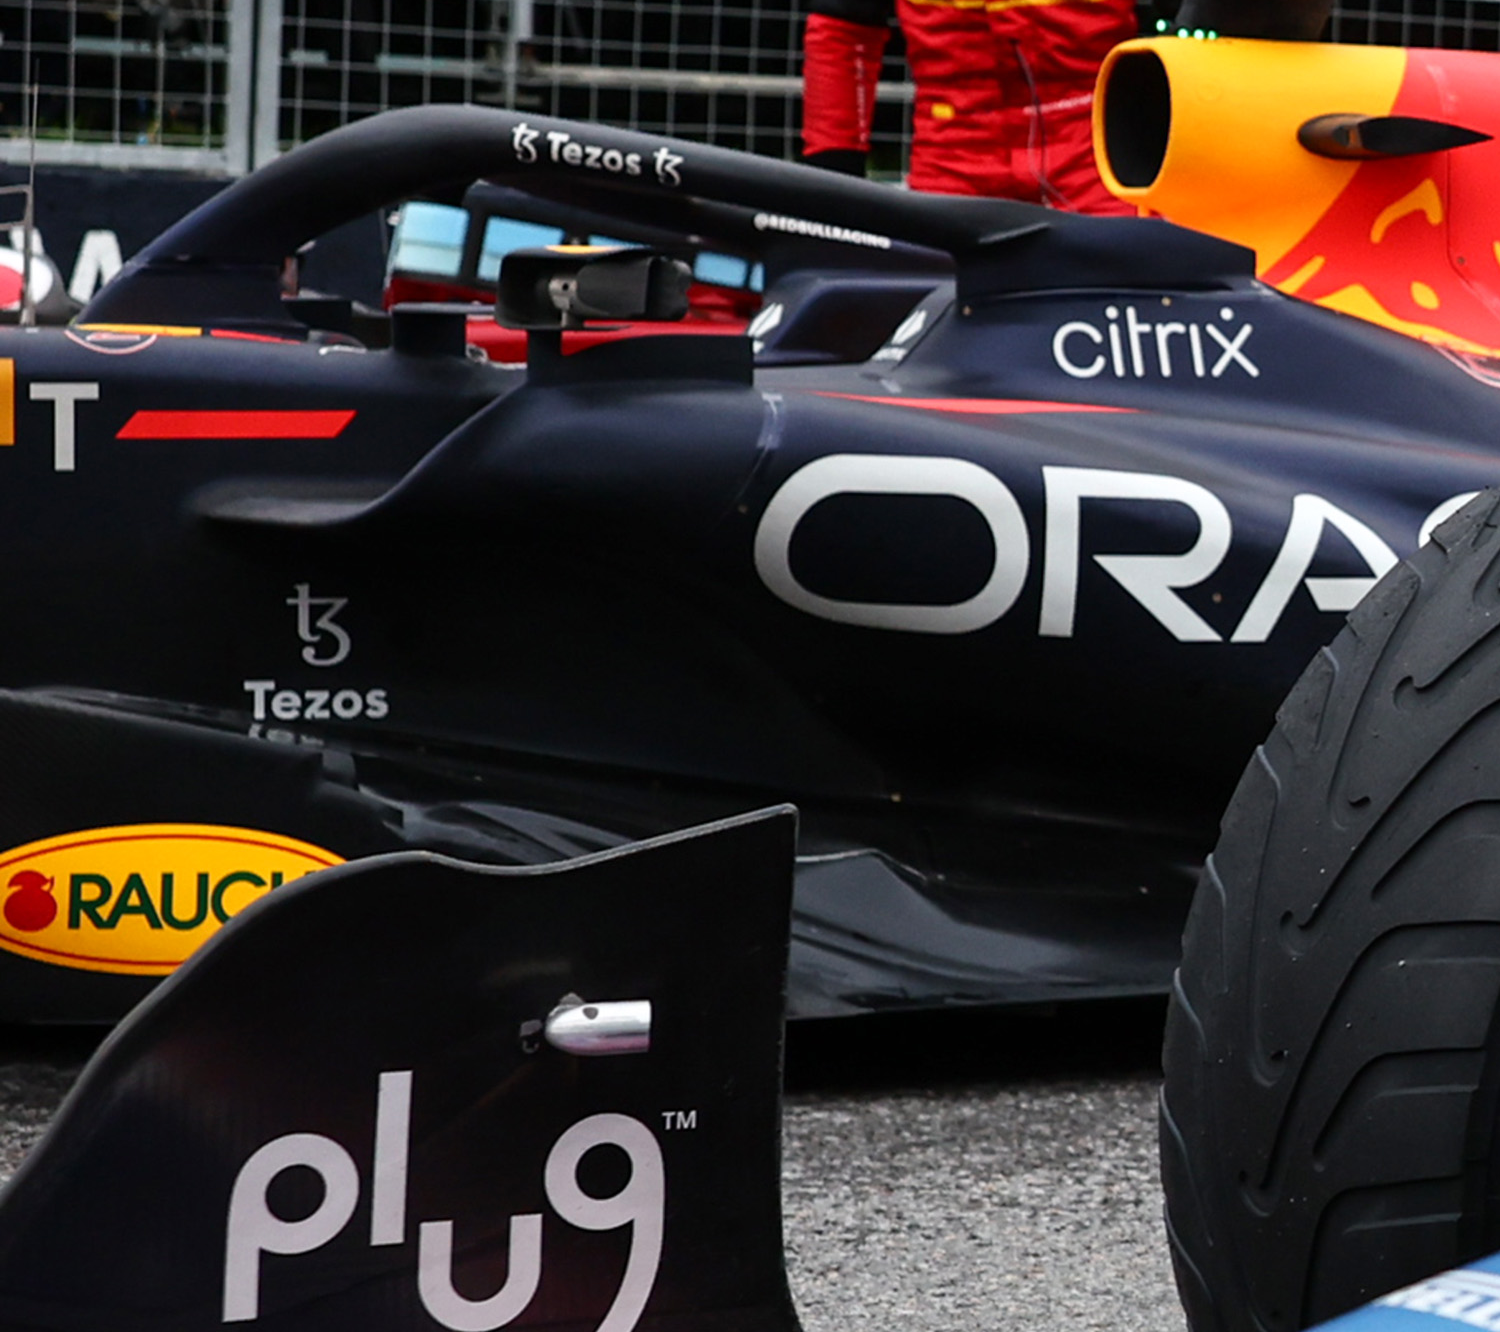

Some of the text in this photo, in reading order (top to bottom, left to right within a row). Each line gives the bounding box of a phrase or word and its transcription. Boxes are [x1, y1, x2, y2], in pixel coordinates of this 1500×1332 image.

[545, 131, 642, 176] Tezos
[753, 211, 892, 250] @REDBULLRACING
[1051, 304, 1261, 379] citrix
[754, 454, 1500, 644] ORA
[243, 680, 390, 720] Tezos
